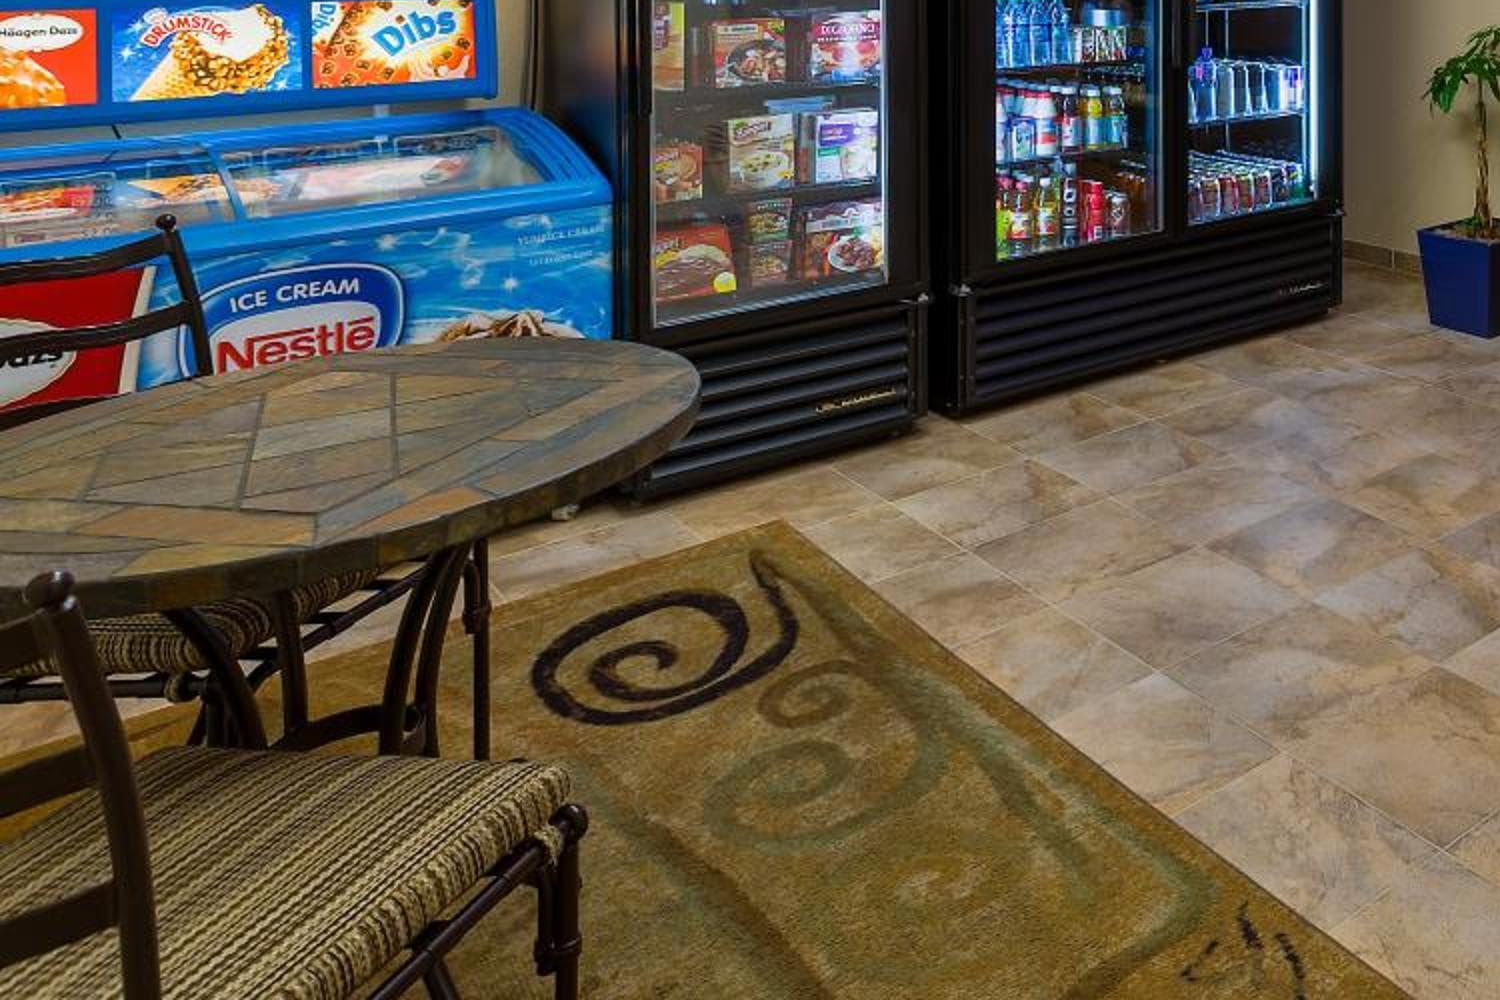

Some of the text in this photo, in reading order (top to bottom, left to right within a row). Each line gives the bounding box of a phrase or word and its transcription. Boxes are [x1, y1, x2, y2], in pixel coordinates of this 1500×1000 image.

[143, 15, 234, 46] DRUMSTICK
[312, 3, 336, 34] Dib
[371, 10, 457, 57] Dibs
[229, 278, 361, 313] ICE CREAM
[215, 315, 377, 375] Nestlé
